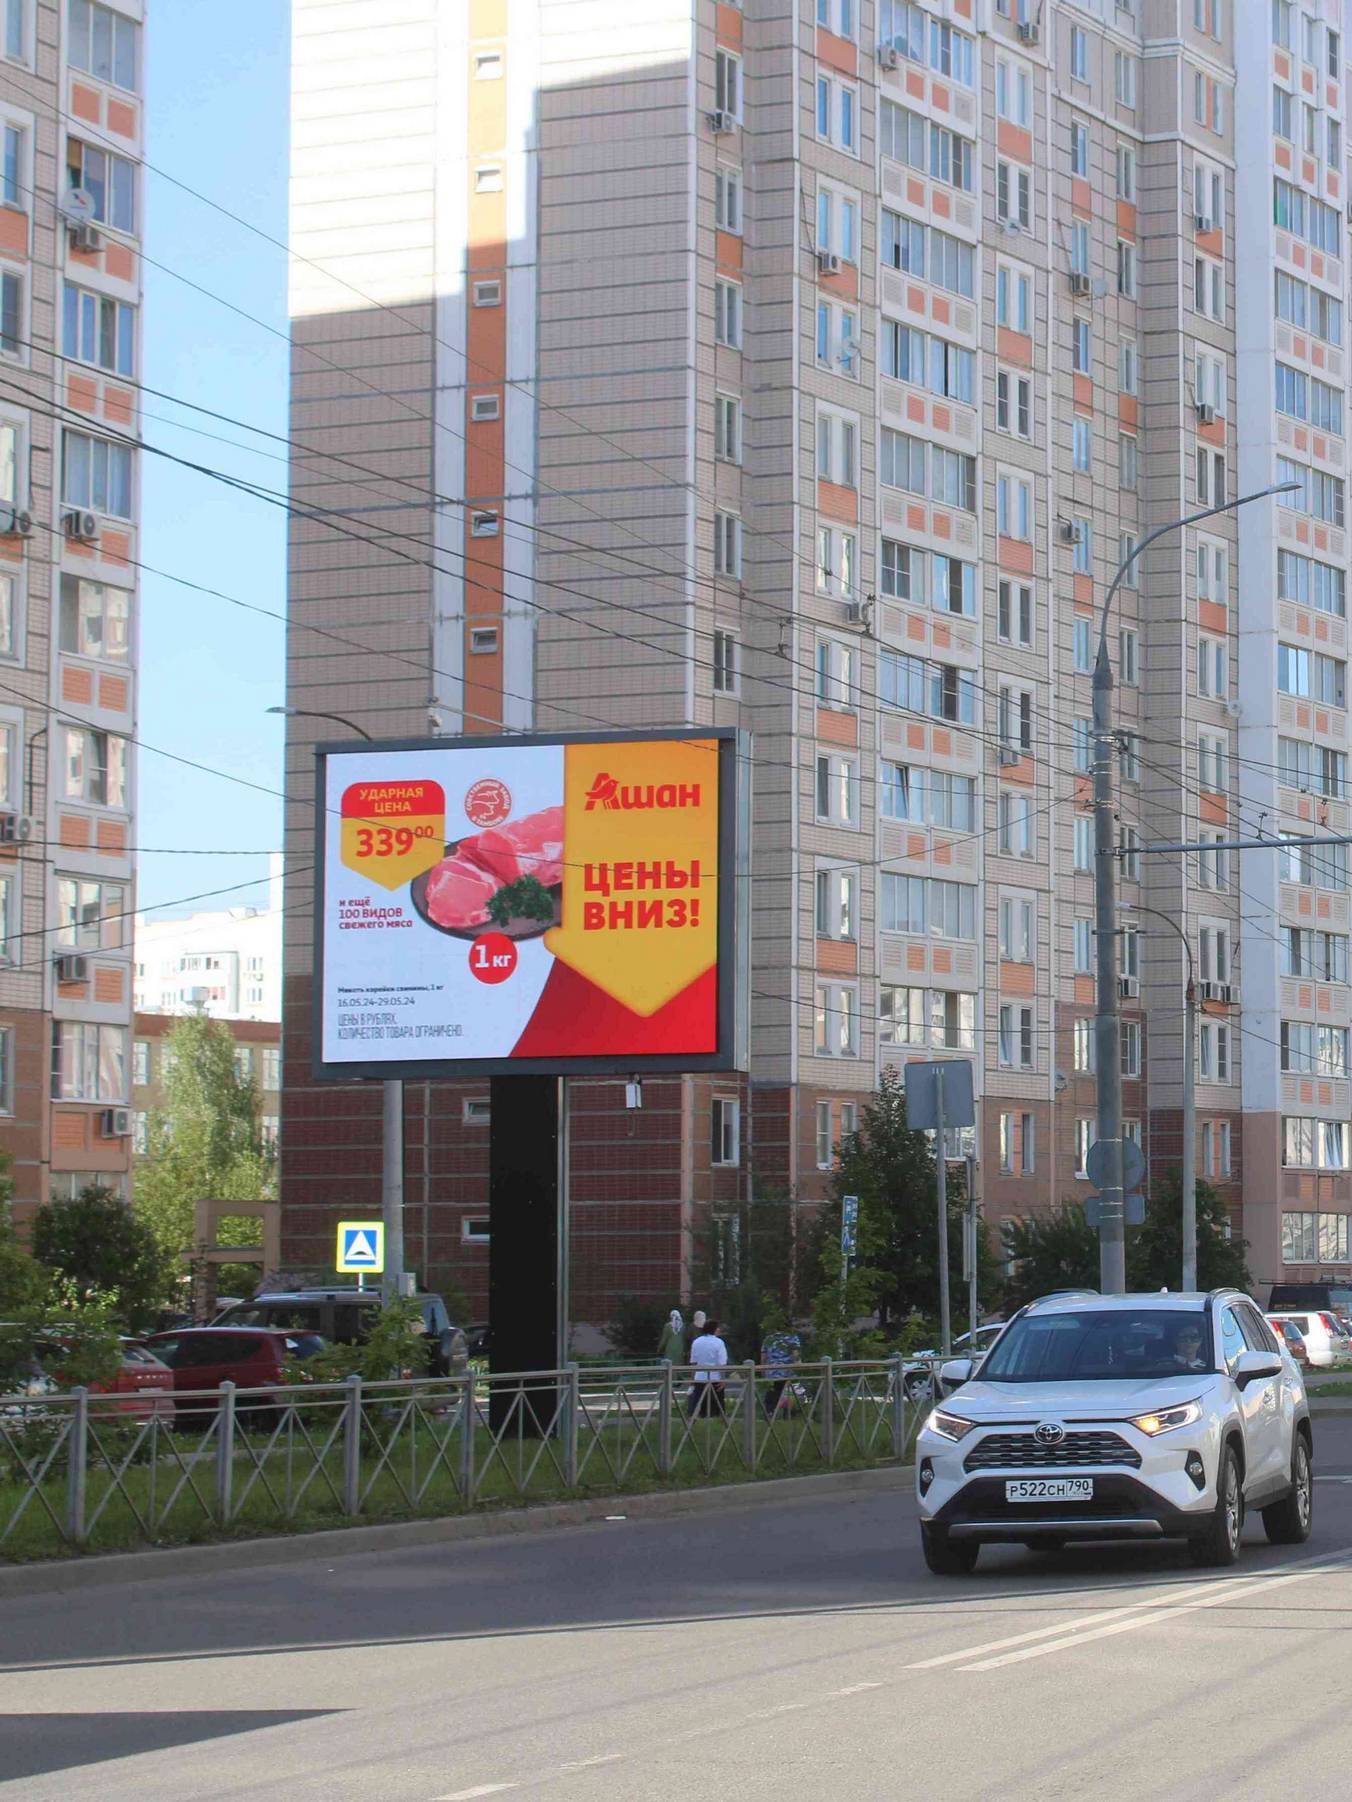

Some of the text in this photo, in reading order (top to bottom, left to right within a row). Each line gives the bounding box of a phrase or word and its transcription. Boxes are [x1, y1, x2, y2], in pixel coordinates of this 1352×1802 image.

[360, 787, 424, 801] УДАРНАЯ
[584, 772, 700, 811] Ашан
[374, 801, 412, 814] ЦЕНА
[355, 827, 414, 857] 339
[584, 860, 700, 897] ЦЕНЫ
[348, 896, 371, 907] ещё
[339, 907, 403, 920] 100 ВИДОВ
[583, 899, 700, 931] ВНИЗ!
[339, 920, 413, 930] свежего мяса
[475, 944, 512, 968] 1 кг
